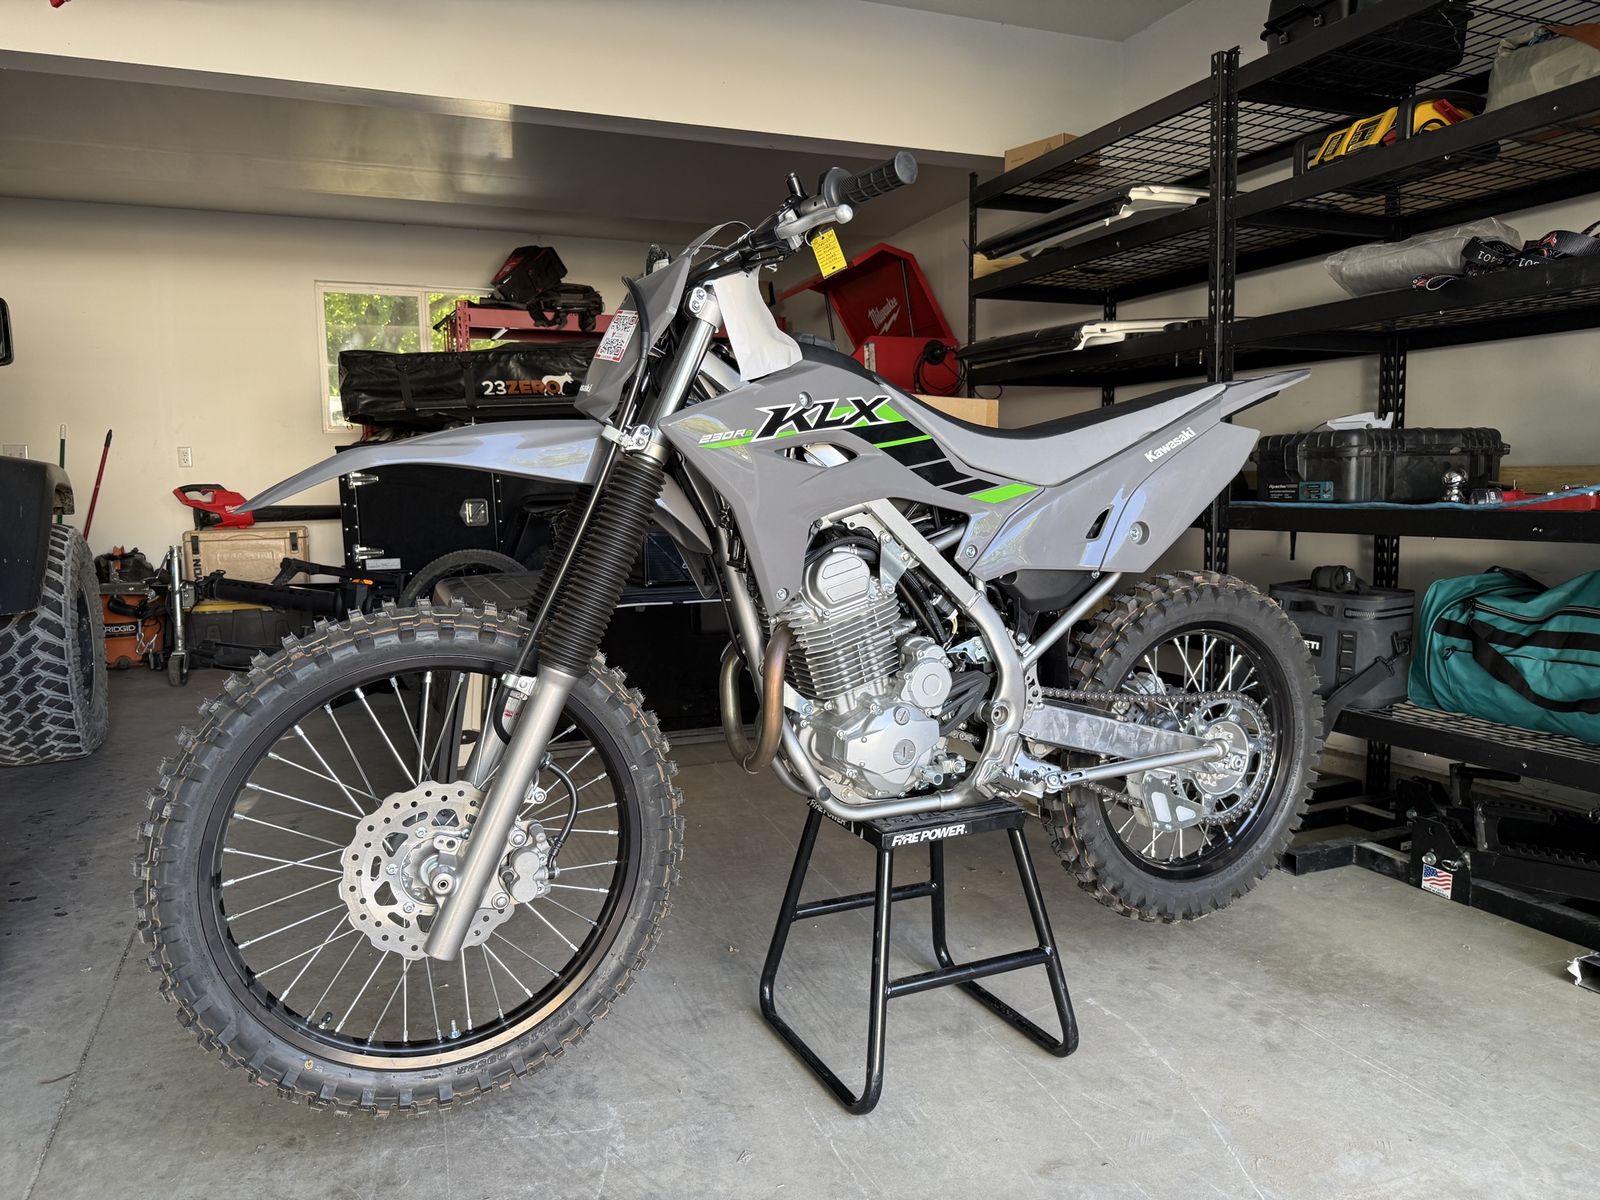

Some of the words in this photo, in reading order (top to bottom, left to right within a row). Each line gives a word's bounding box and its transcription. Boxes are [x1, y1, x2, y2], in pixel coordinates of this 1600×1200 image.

[481, 379, 561, 396] 23ZERO
[754, 395, 892, 442] KLX
[1144, 427, 1197, 463] Kawasaki
[104, 624, 136, 633] RIDGID
[1304, 640, 1320, 650] ETI
